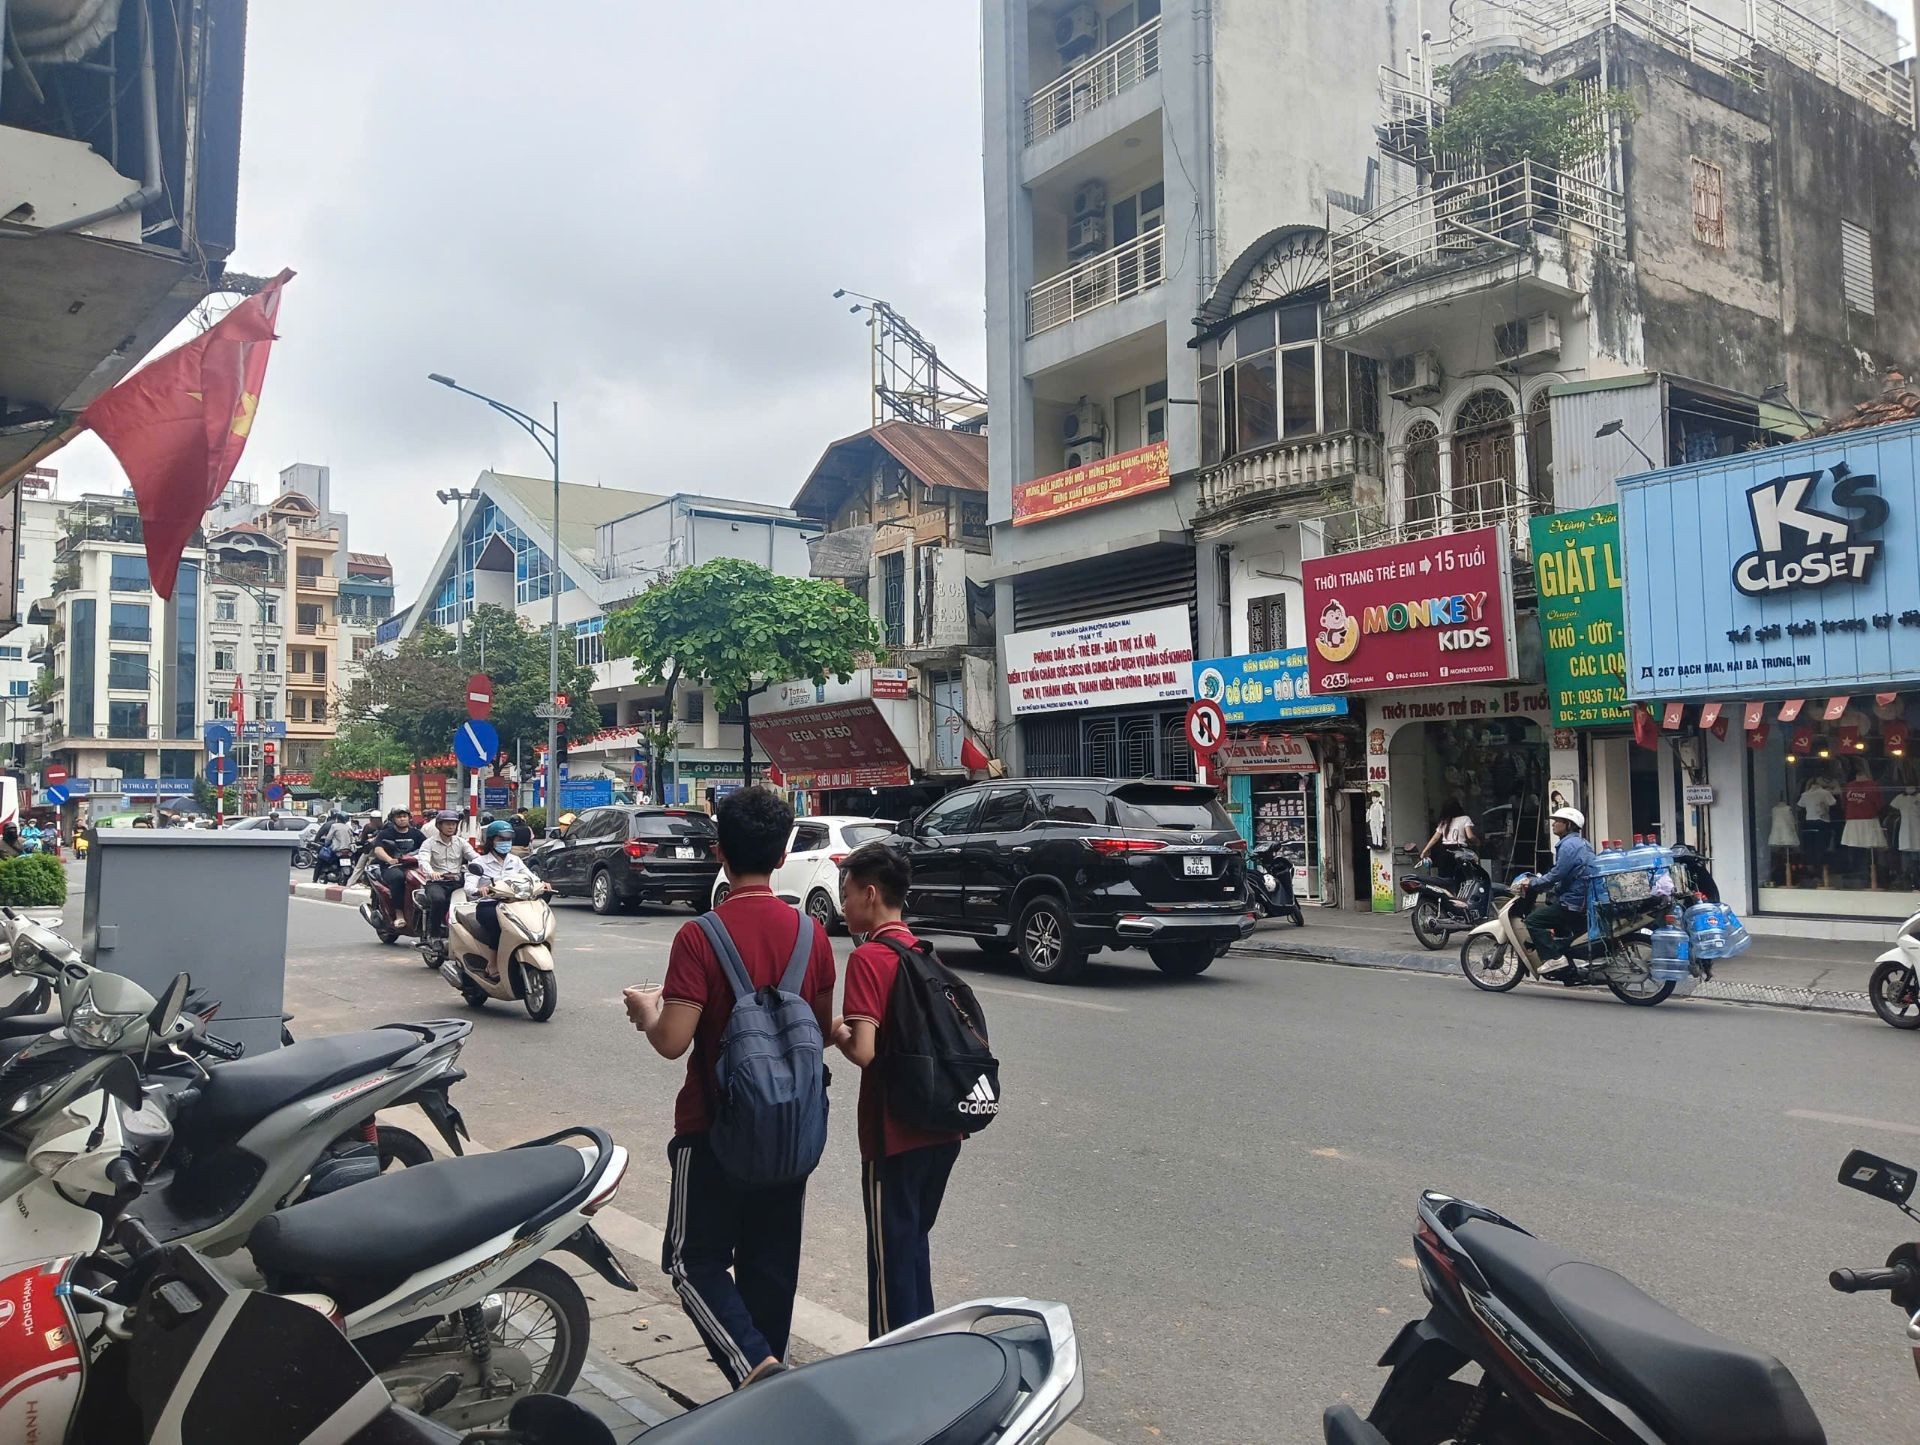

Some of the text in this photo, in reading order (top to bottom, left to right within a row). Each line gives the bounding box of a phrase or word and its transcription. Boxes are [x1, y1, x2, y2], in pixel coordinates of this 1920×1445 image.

[1314, 543, 1486, 591] THỜI TRANG TRẺ EM 15 TUỔI
[1539, 538, 1596, 604] GIẶT
[1363, 590, 1488, 635] MONKEY
[1438, 626, 1491, 652] KIDS
[1548, 623, 1575, 649] KHÔ
[1588, 618, 1614, 646] ƯỚT
[1569, 651, 1597, 678] CÁC
[1658, 655, 1811, 678] 267 BẠCH MAI, HAI BÀ TRƯNG, HN
[1327, 673, 1346, 688] 265
[1408, 702, 1445, 718] TRANG
[1503, 690, 1520, 713] 15
[1560, 687, 1625, 706] ĐT: 0936 742
[1560, 709, 1578, 721] ĐC:
[1579, 708, 1598, 721] 267
[1186, 865, 1210, 876] 946.27
[1191, 856, 1204, 866] 30E
[957, 1100, 1000, 1115] adidas
